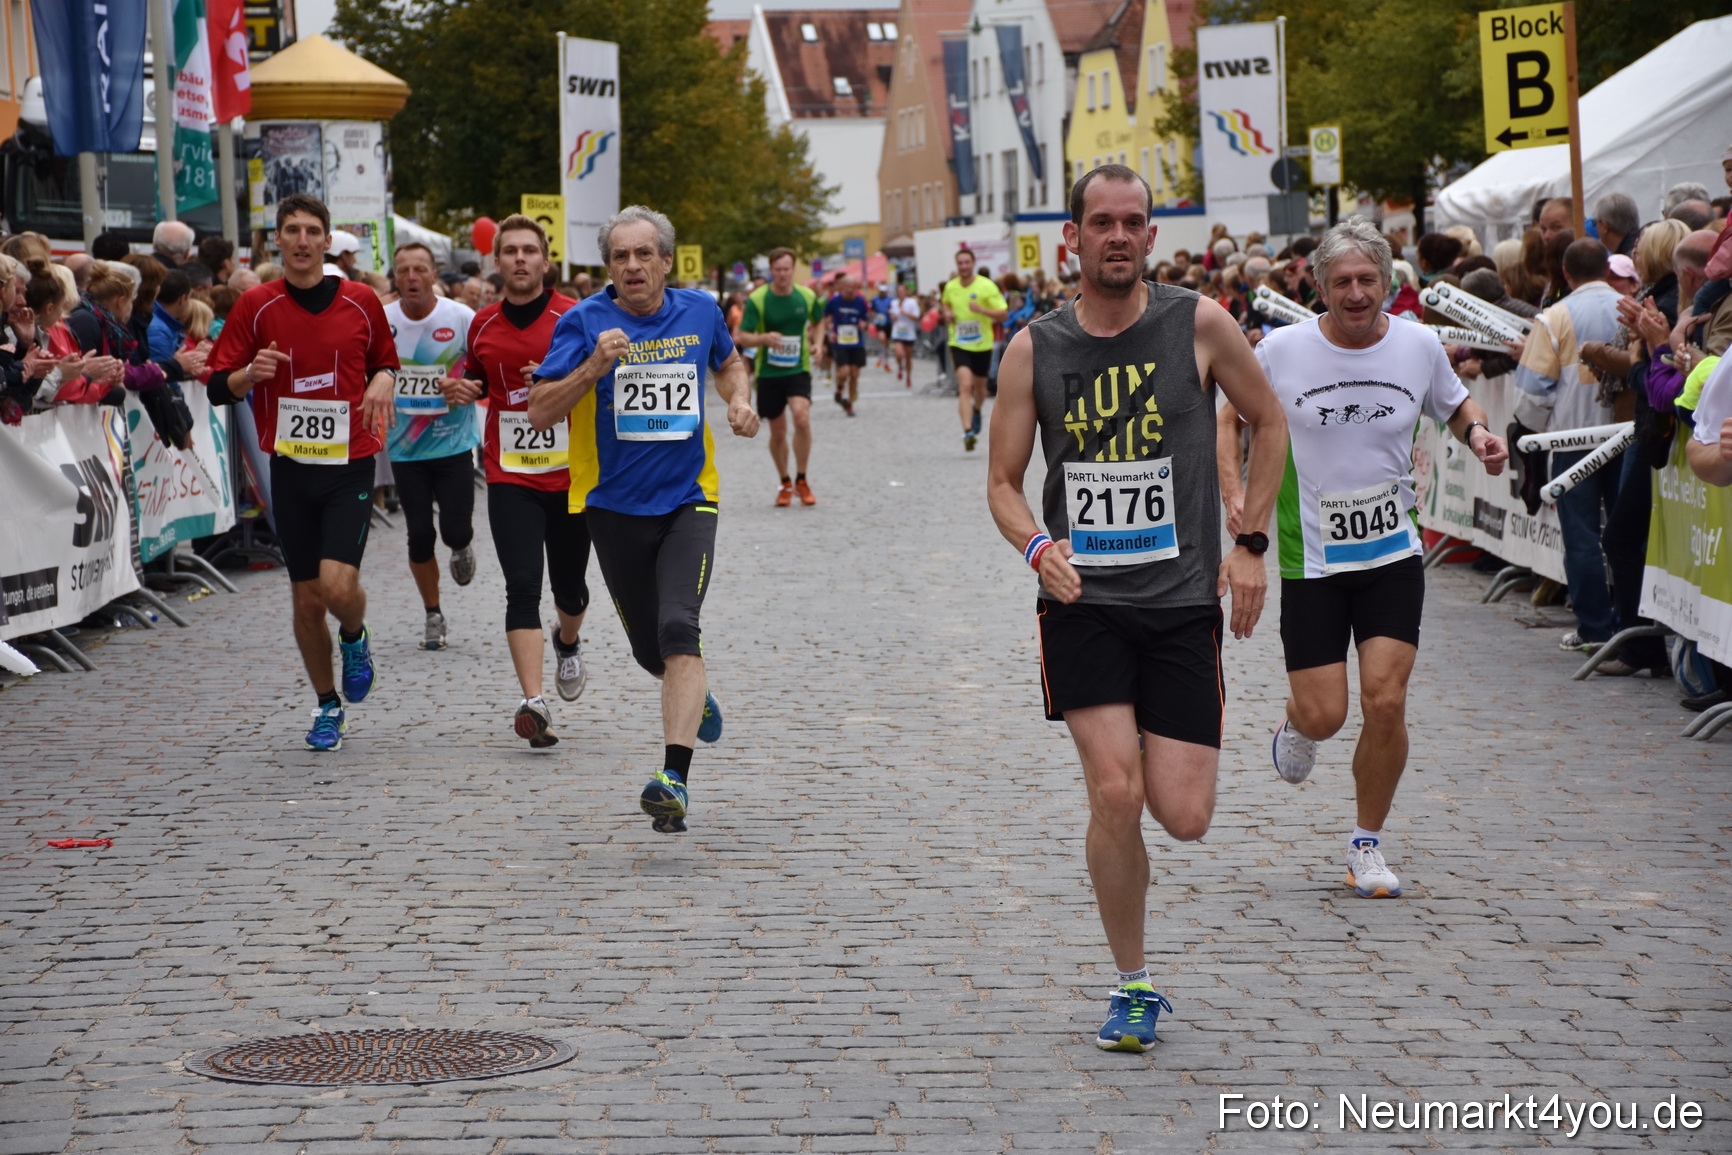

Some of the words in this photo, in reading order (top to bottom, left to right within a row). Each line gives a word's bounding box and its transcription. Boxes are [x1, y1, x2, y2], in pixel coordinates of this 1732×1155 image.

[1491, 10, 1564, 41] Block
[567, 75, 615, 97] swn
[1507, 50, 1555, 119] B
[527, 197, 561, 211] Block
[1023, 244, 1036, 262] D
[683, 256, 696, 273] D
[628, 335, 700, 353] EUMARKTER
[619, 347, 687, 368] STADTLAUF
[399, 376, 441, 395] 2729
[1063, 362, 1158, 423] RUN
[410, 399, 432, 408] Ulrich
[623, 383, 690, 411] 2512
[280, 404, 302, 412] PARTL
[290, 415, 335, 440] 289
[647, 419, 669, 430] Otto
[513, 426, 556, 450] 229
[1065, 413, 1164, 462] THIS
[1550, 435, 1587, 449] BMW
[294, 445, 328, 455] Markus
[521, 456, 549, 464] Martin
[1569, 455, 1602, 484] BMW
[1067, 471, 1099, 482] PARTL
[1101, 471, 1154, 482] Neumarkt
[1077, 485, 1165, 525] 2176
[1321, 500, 1351, 509] PARTL
[1352, 490, 1390, 507] Neumarkt
[1329, 500, 1399, 541] 3043
[1086, 535, 1158, 551] Alexander
